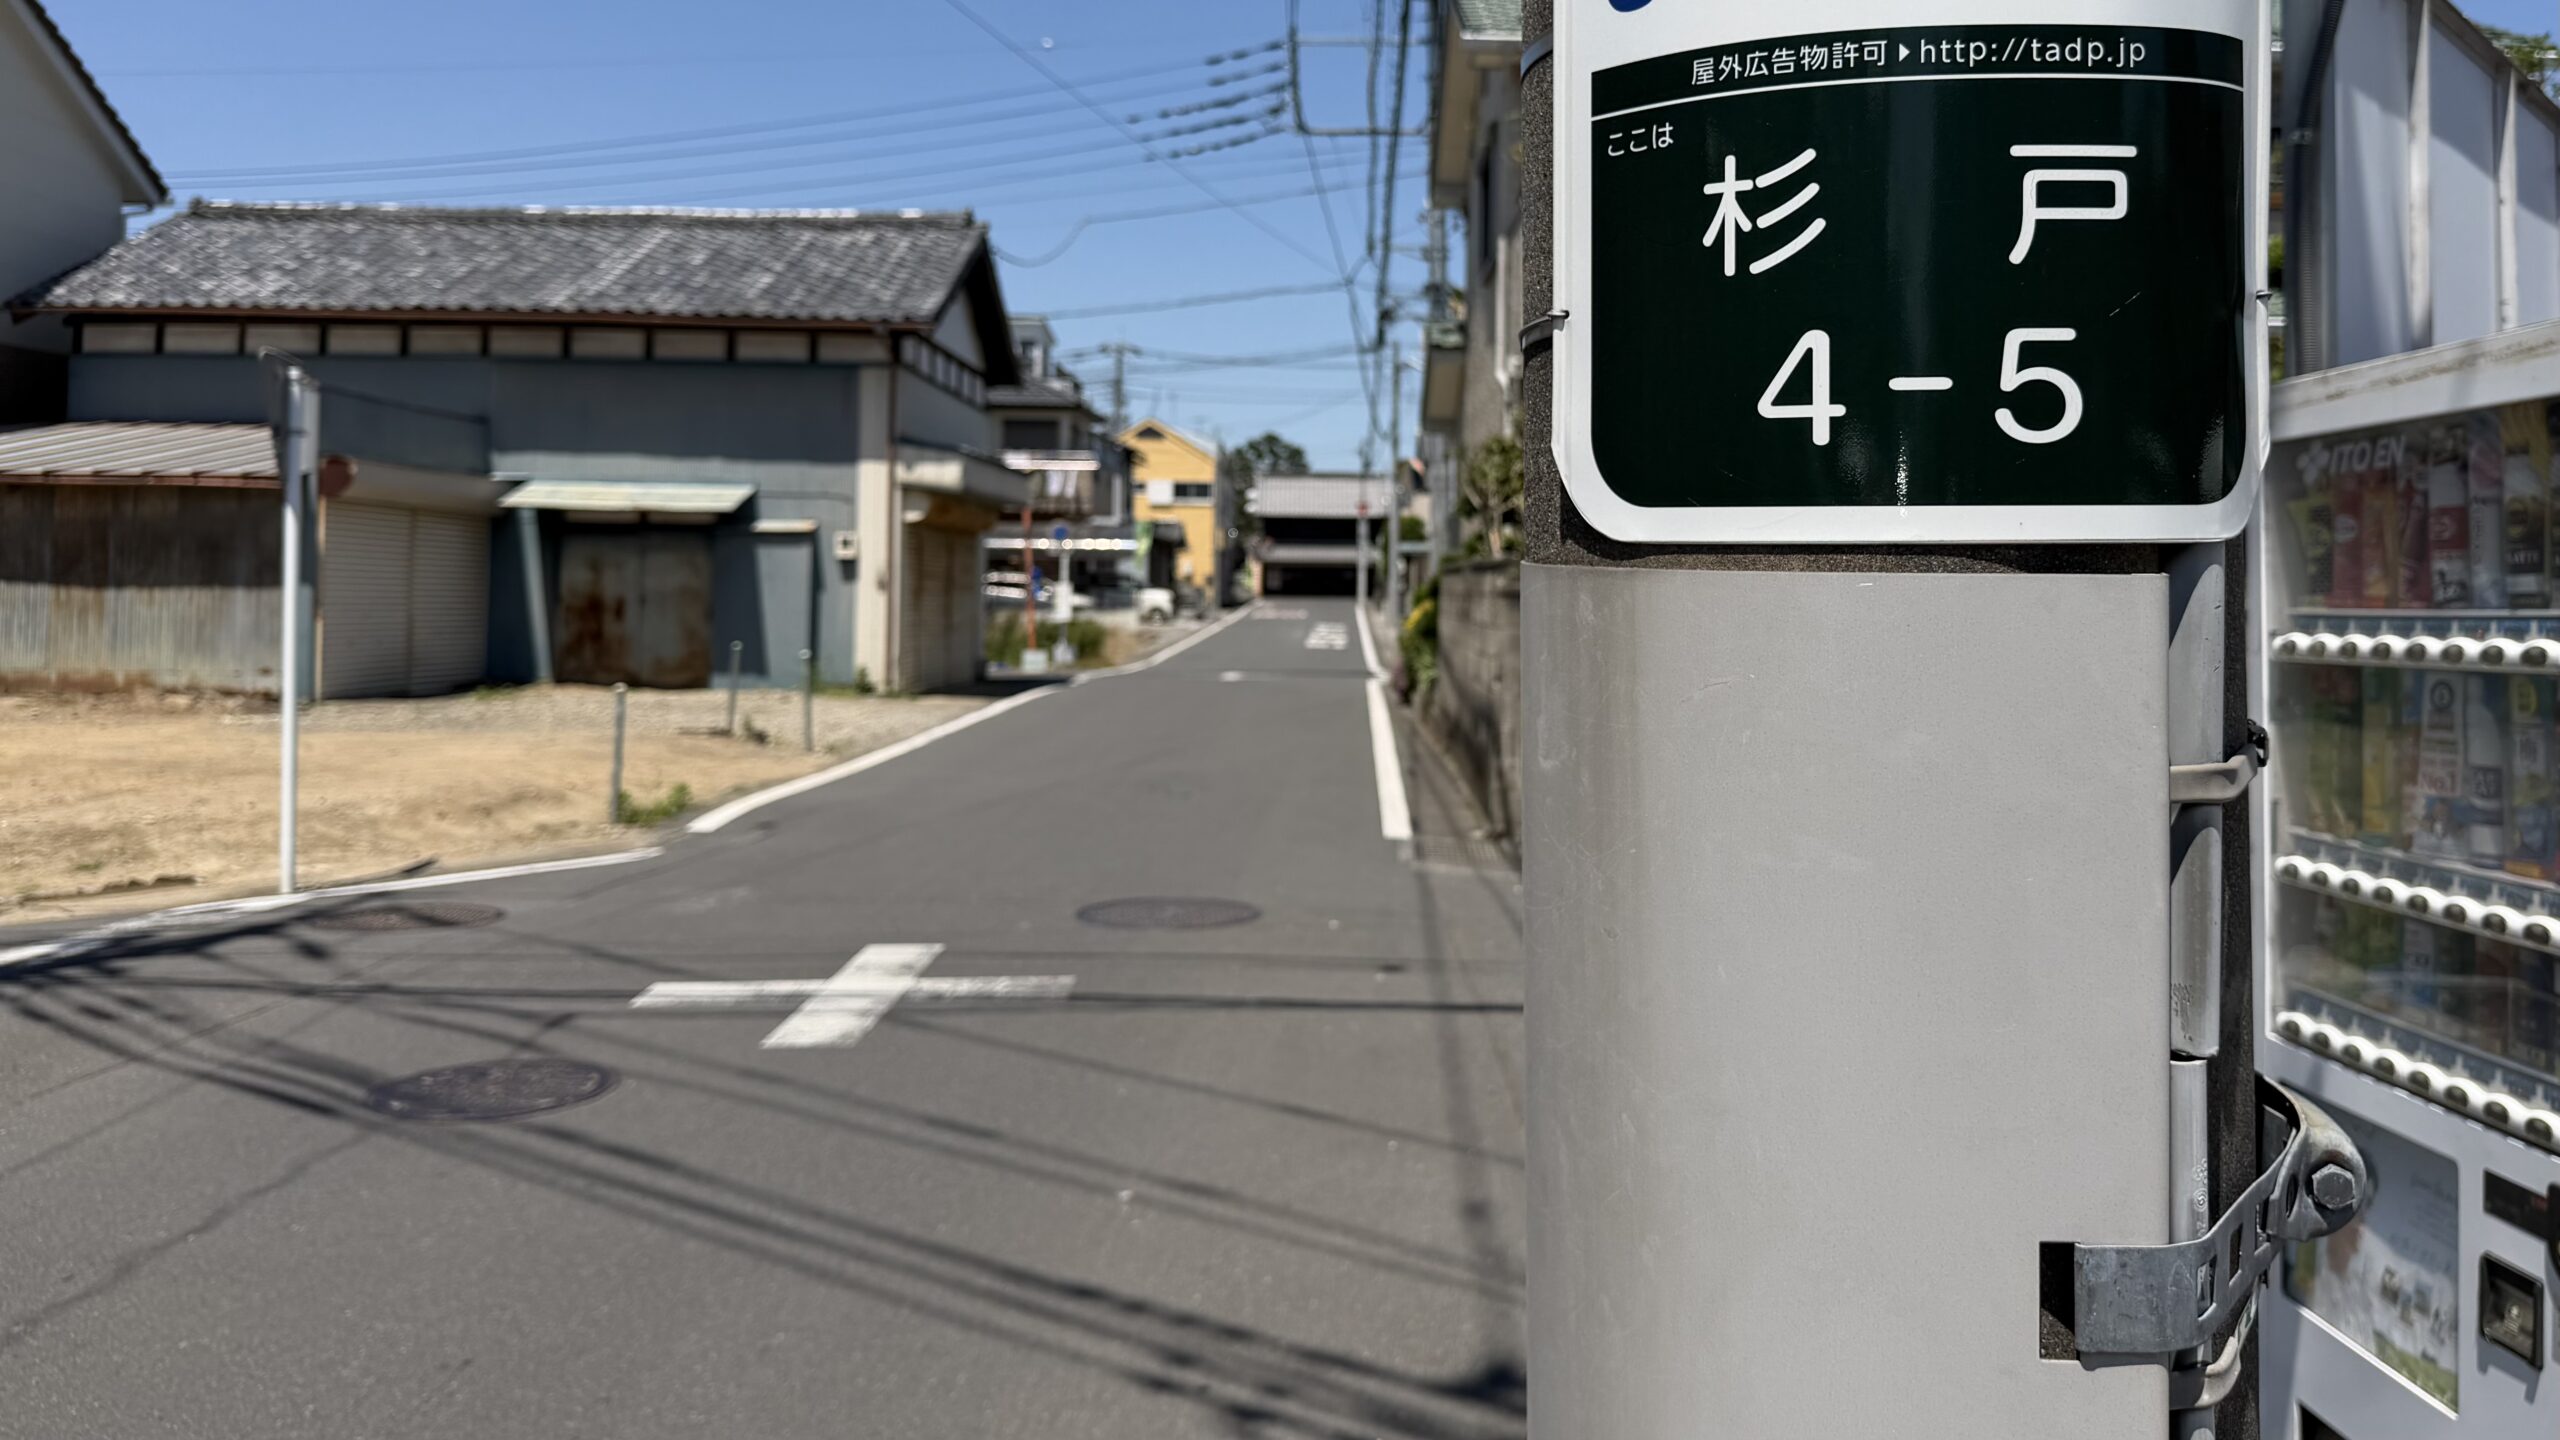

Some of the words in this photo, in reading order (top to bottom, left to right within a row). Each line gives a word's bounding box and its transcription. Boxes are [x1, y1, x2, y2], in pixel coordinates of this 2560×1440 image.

[1691, 40, 1888, 85] 屋外広告物許可
[1921, 38, 2145, 67] http://tadp.jp
[1608, 123, 1673, 156] ここは
[1758, 328, 2082, 445] 4-5
[2329, 442, 2371, 475] ITO
[2373, 436, 2406, 468] EN
